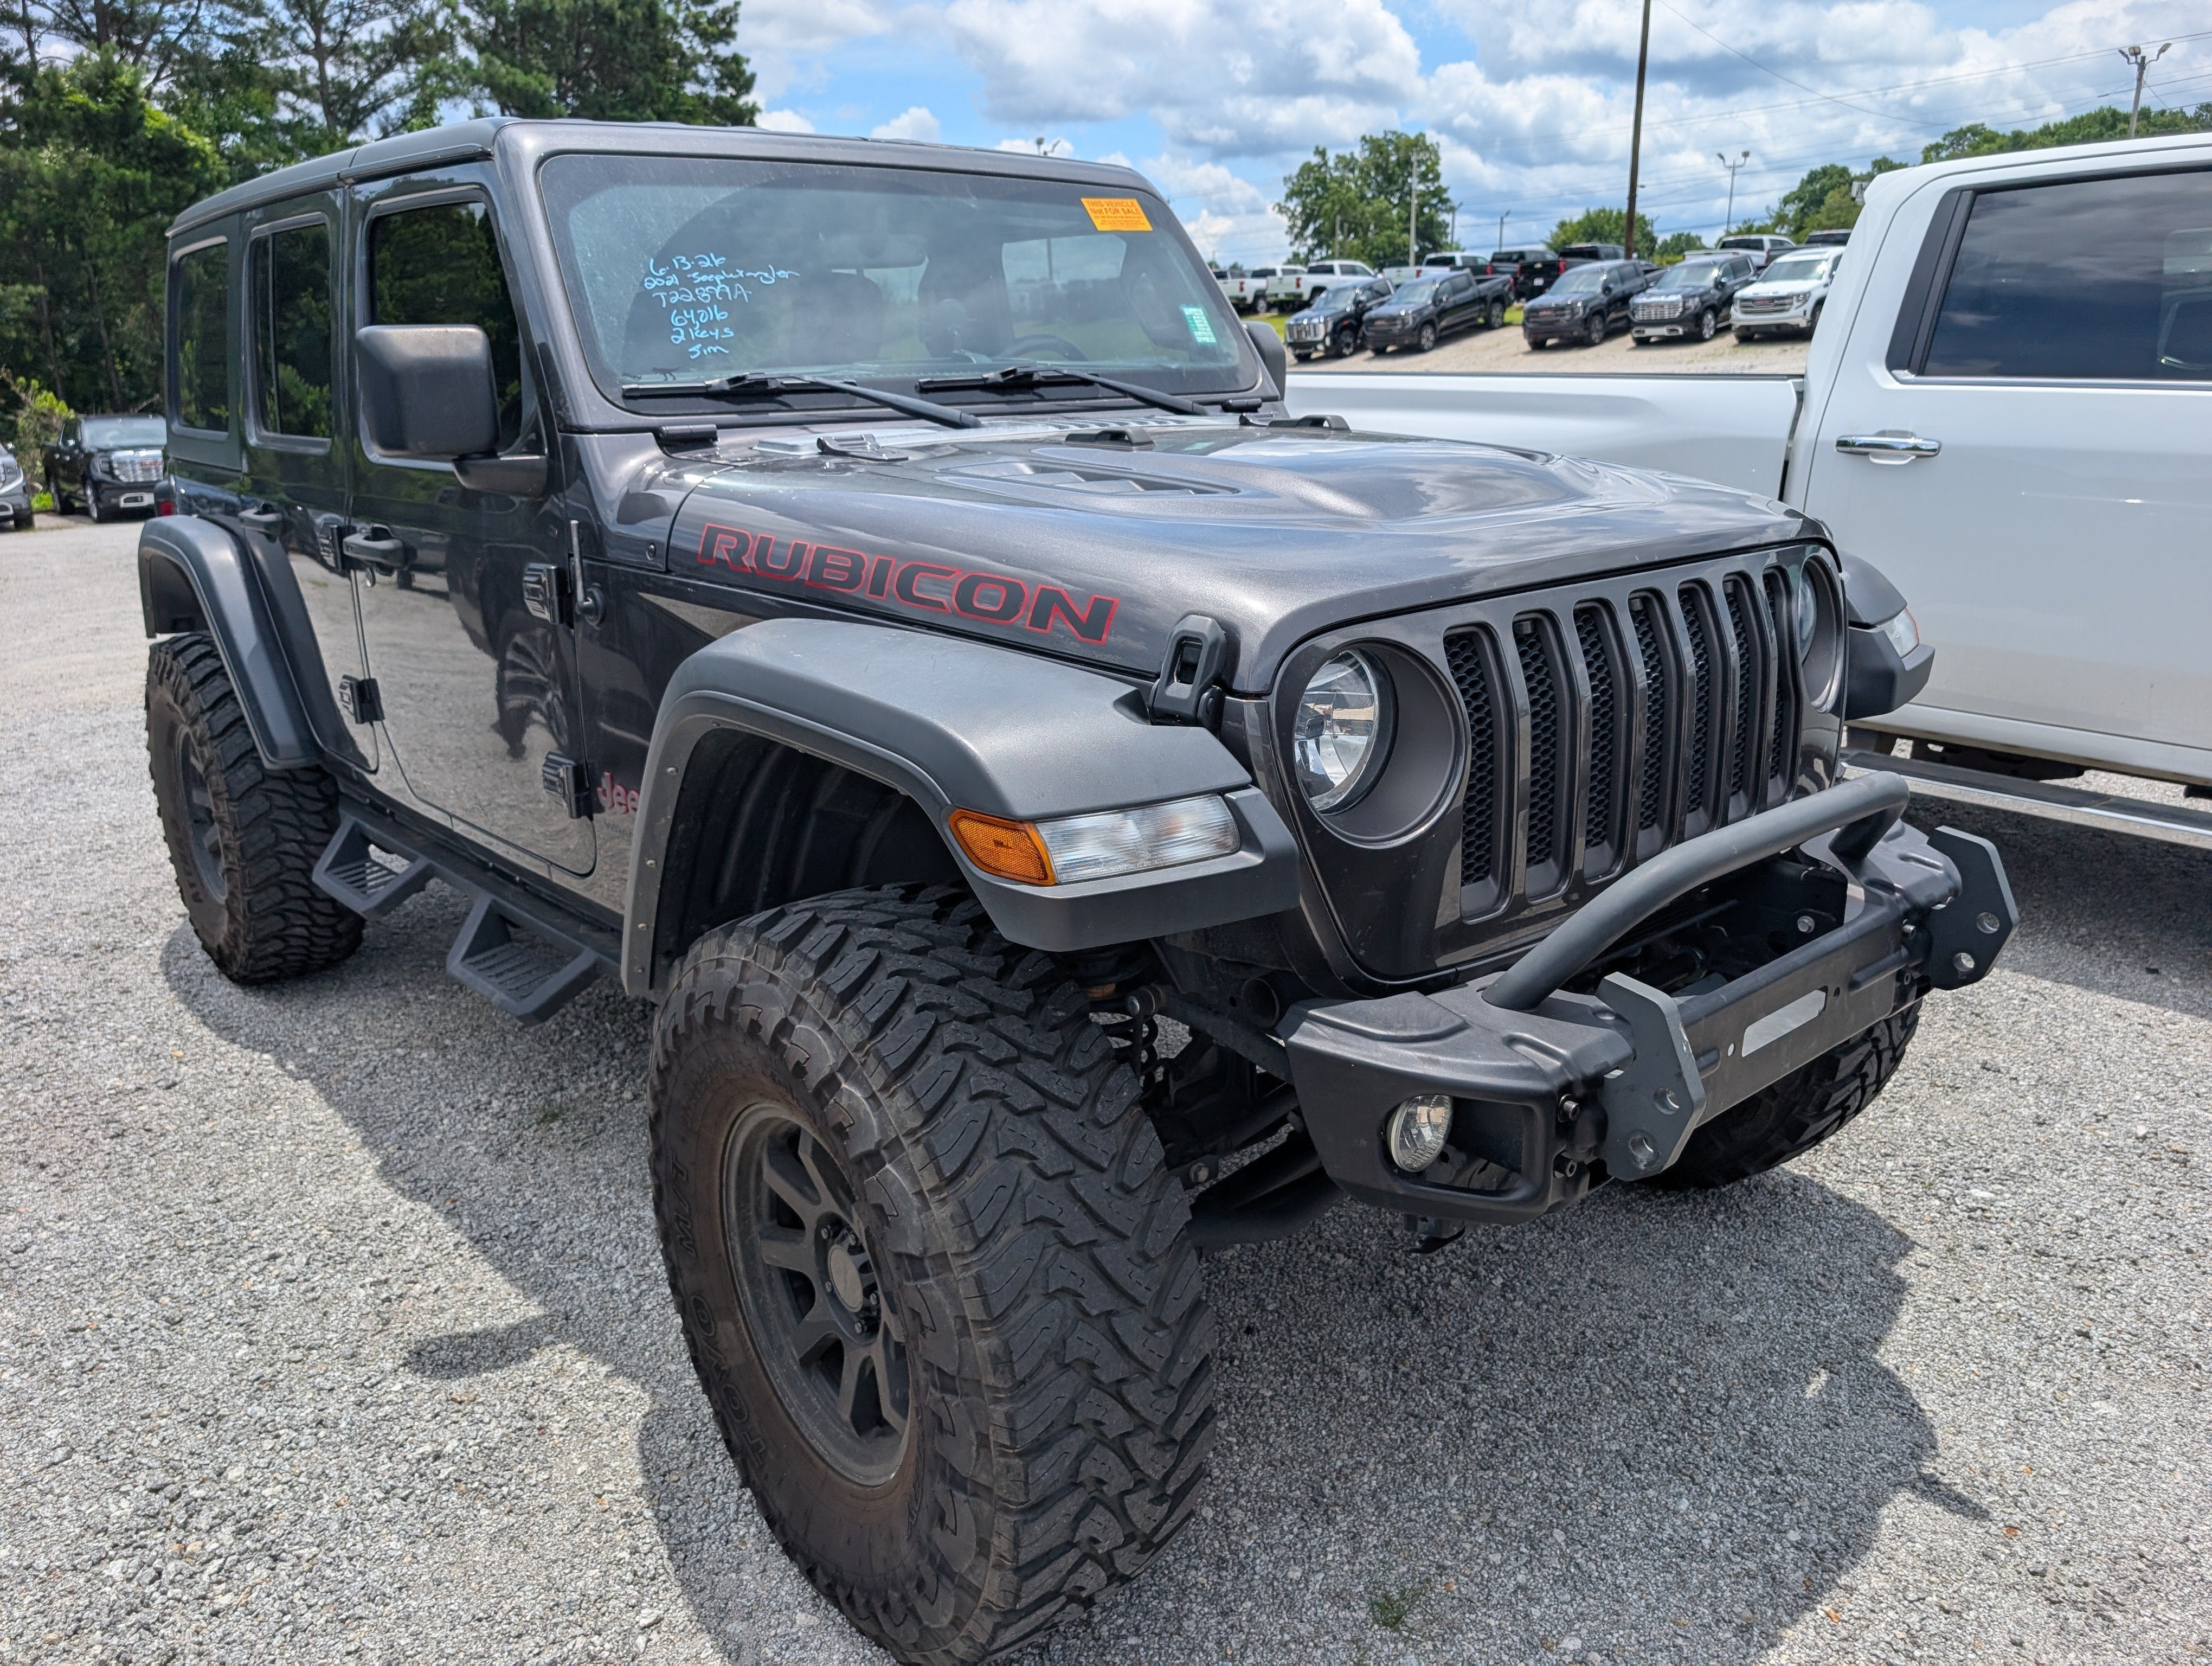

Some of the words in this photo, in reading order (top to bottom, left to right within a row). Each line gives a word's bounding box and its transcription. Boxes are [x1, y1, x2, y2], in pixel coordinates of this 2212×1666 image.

[670, 327, 686, 344] 2
[697, 523, 1119, 645] RUBICON
[597, 771, 640, 814] Jee
